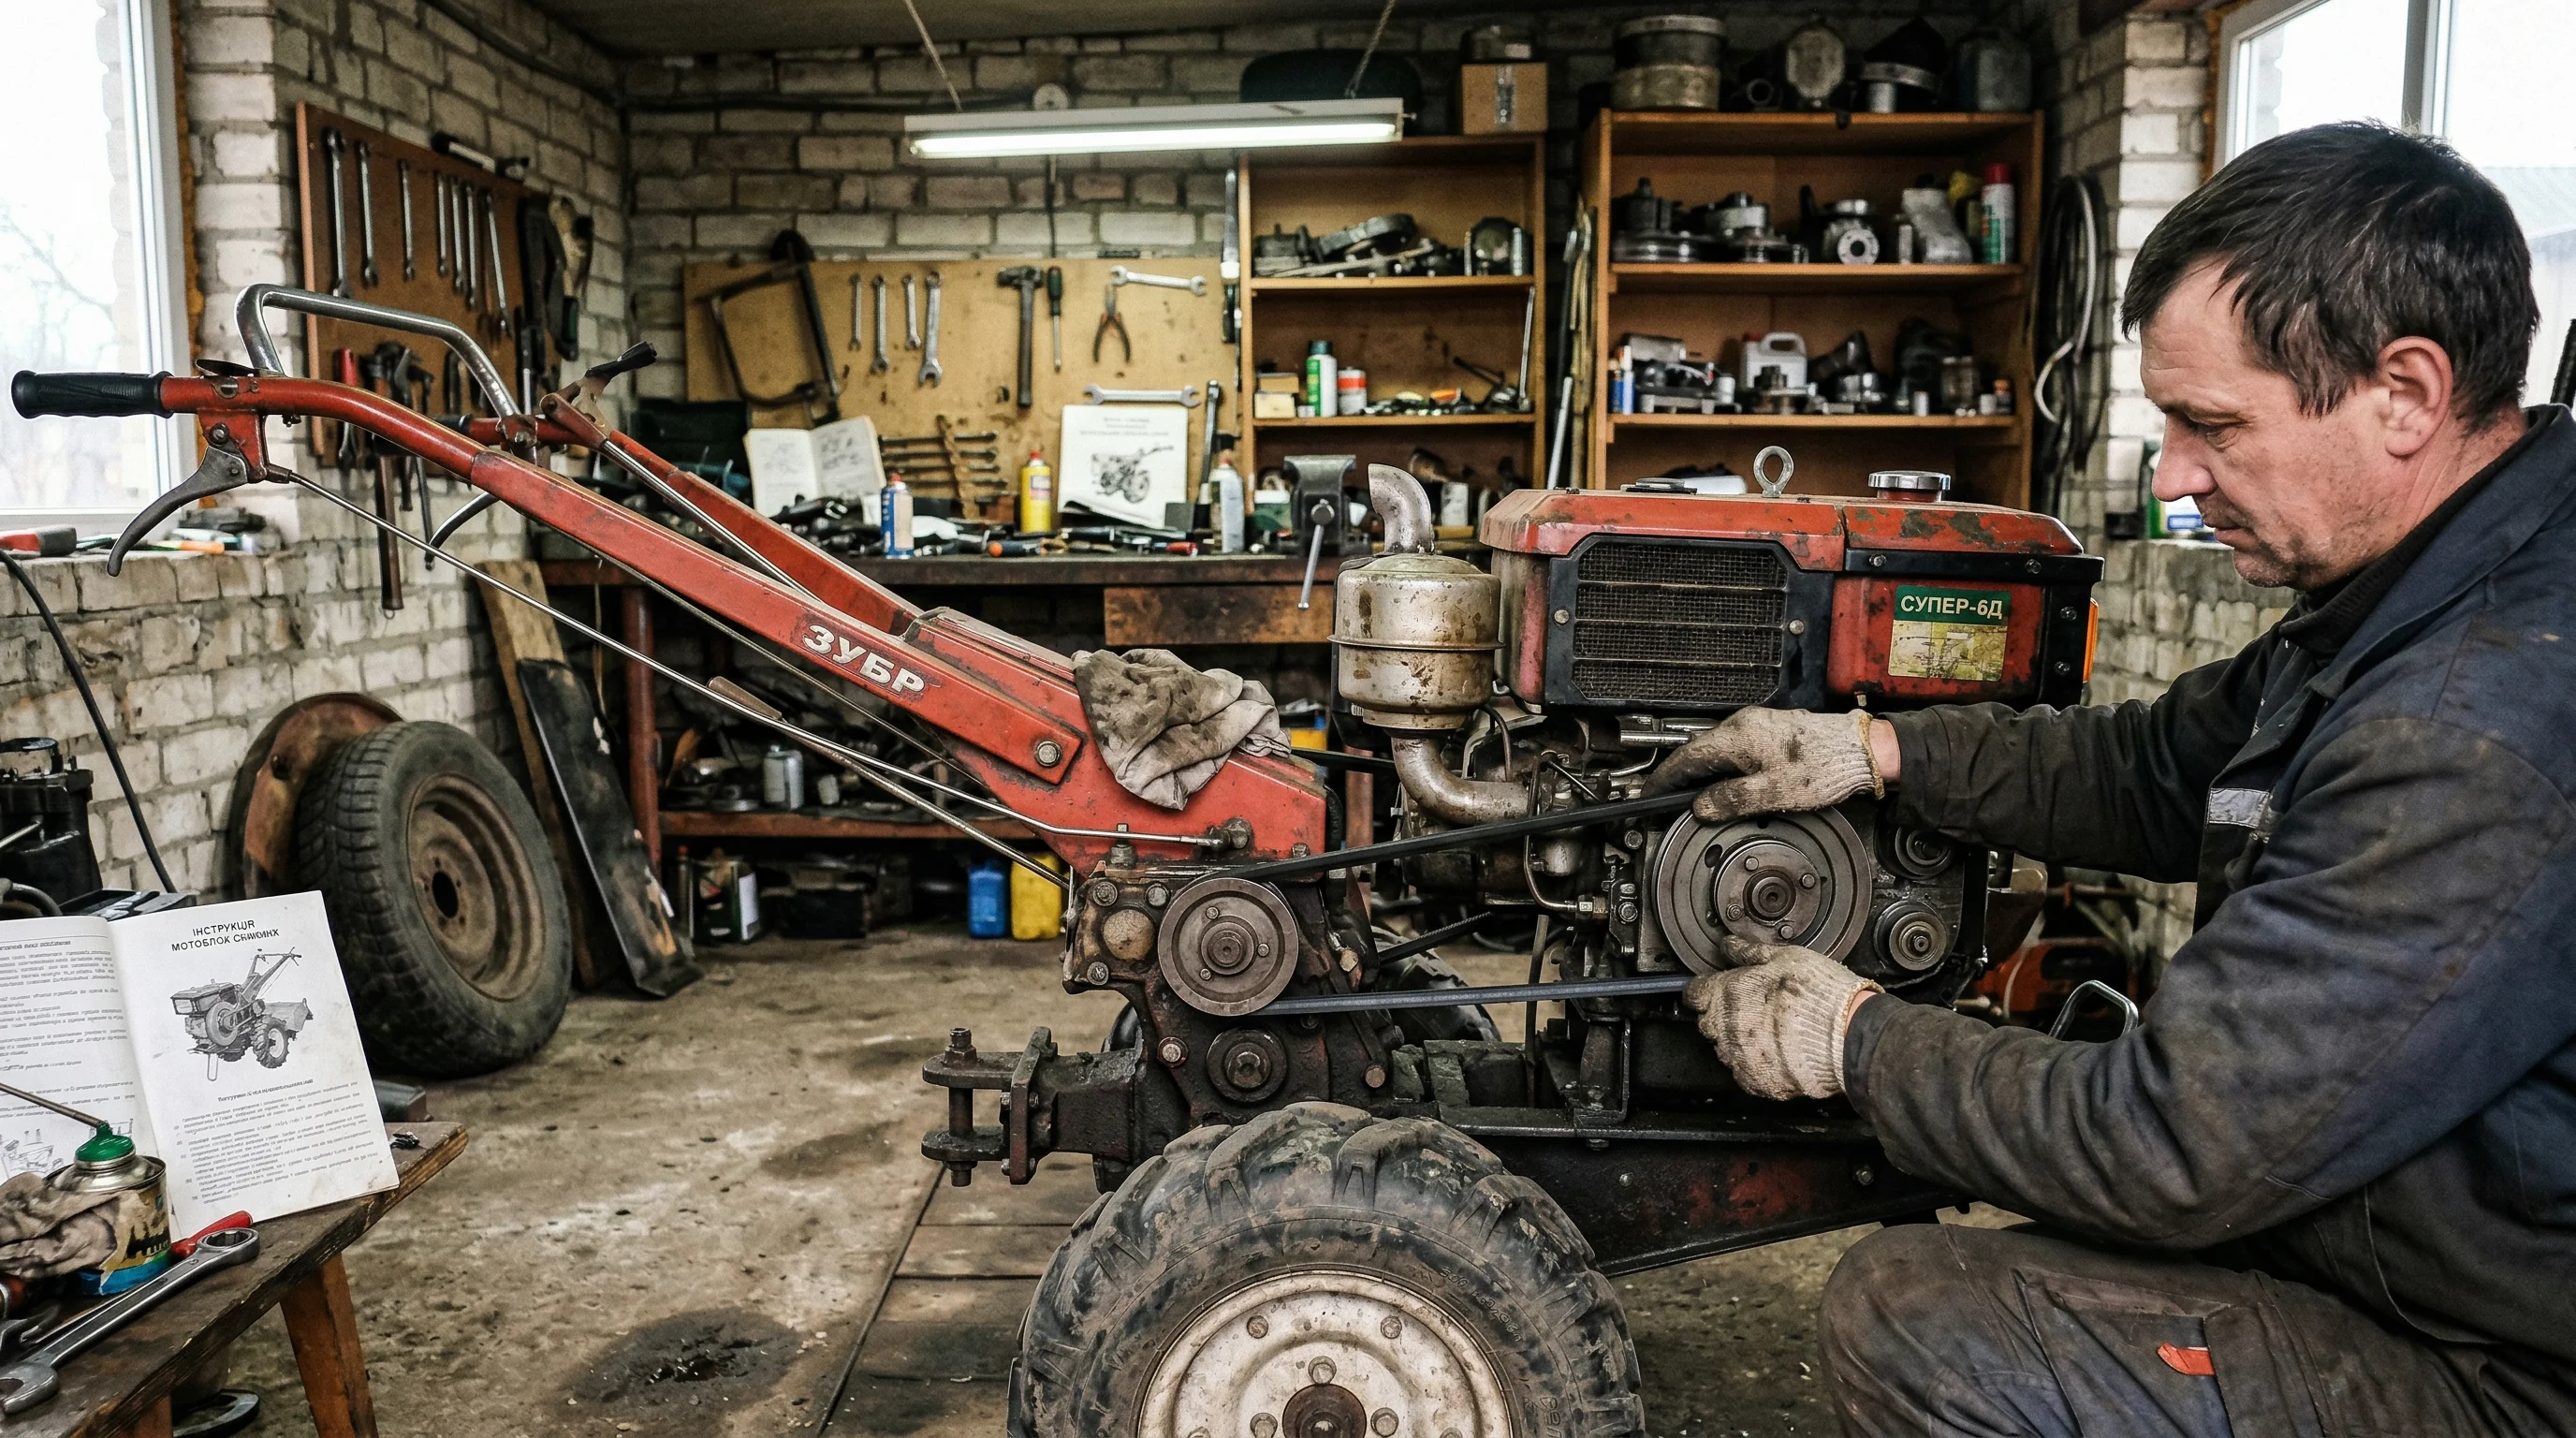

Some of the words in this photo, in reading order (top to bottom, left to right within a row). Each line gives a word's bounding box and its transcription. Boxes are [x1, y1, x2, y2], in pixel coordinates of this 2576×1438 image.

[1900, 594, 2003, 620] СУПЕР-6Д
[802, 624, 925, 693] ЗУБР
[171, 935, 230, 952] МОТОБЛОК
